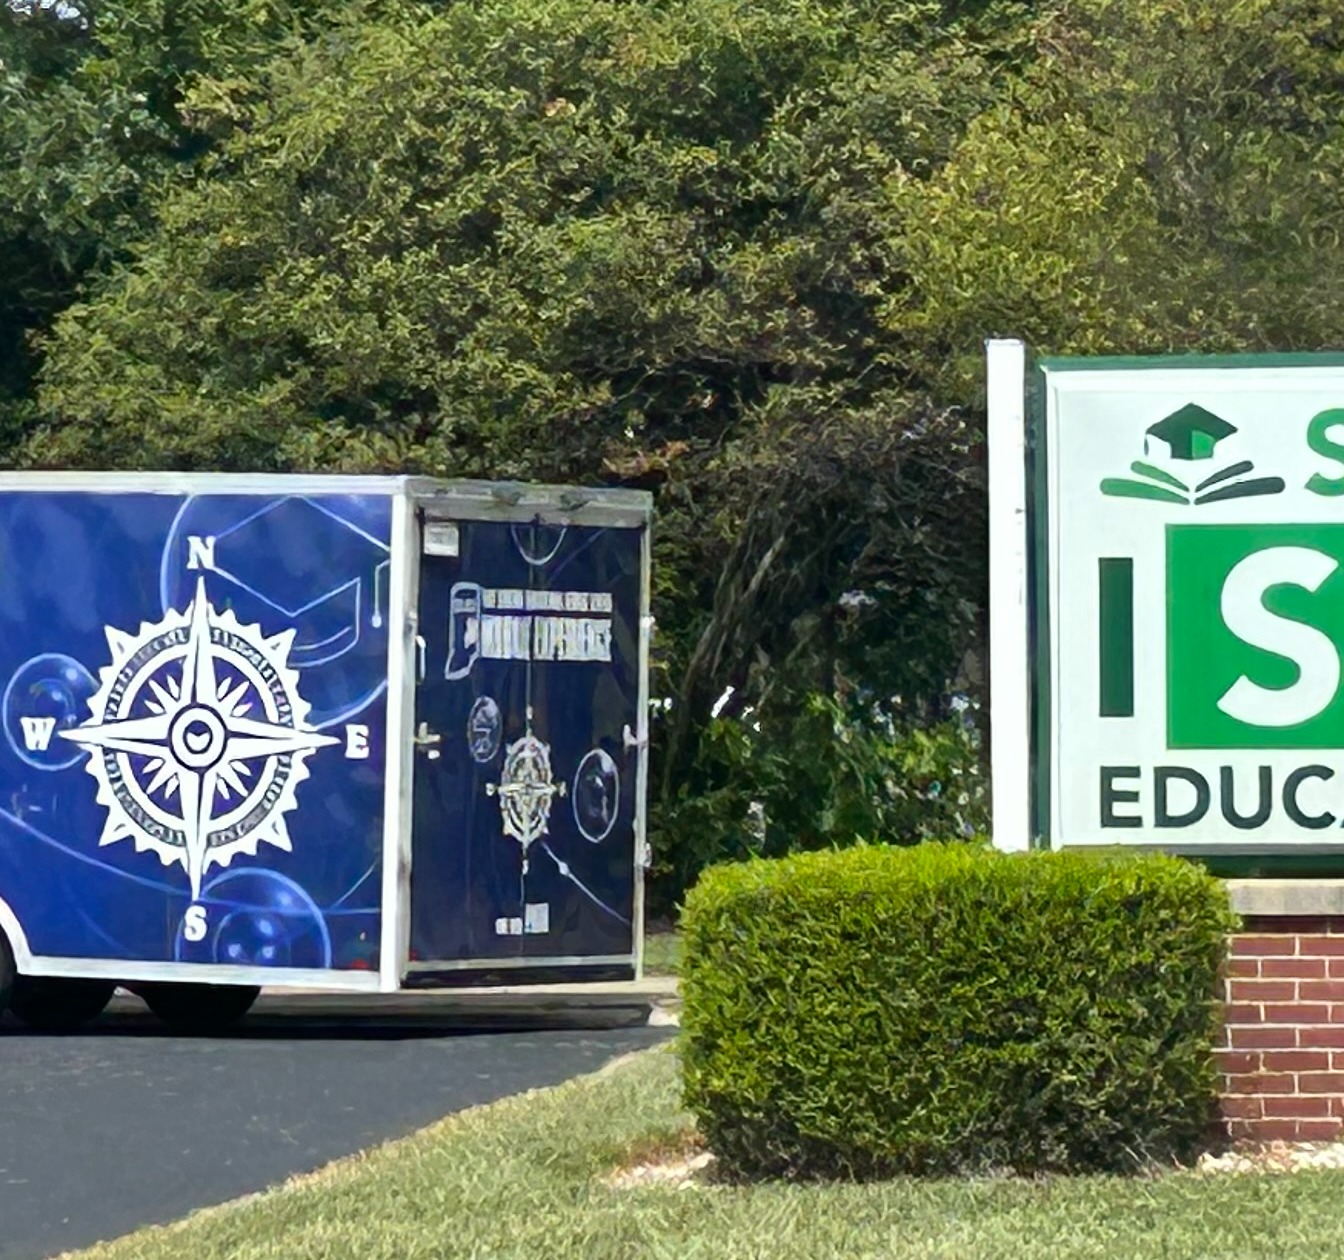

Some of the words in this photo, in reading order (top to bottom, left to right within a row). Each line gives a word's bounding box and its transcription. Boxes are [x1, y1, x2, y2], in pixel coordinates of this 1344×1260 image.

[186, 535, 221, 574] N
[20, 716, 56, 751] W
[345, 723, 370, 759] E
[184, 905, 207, 941] S
